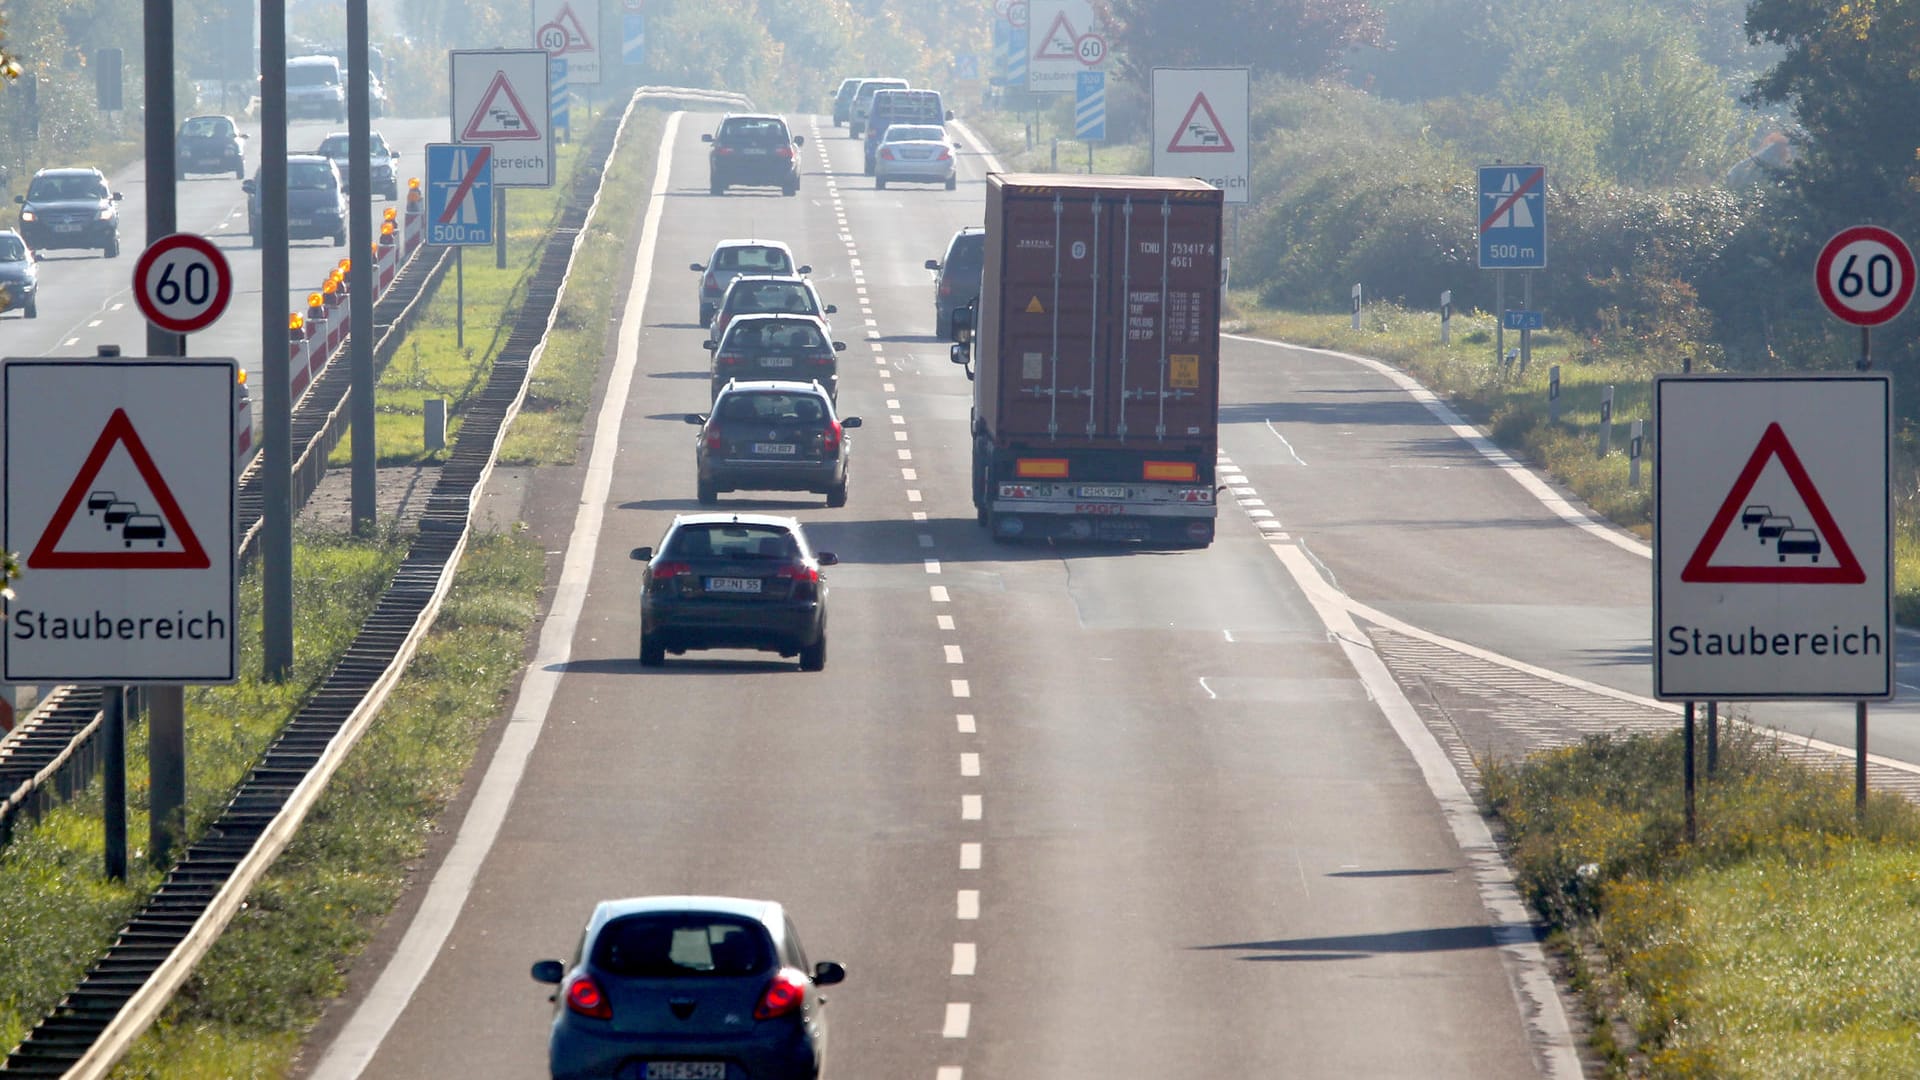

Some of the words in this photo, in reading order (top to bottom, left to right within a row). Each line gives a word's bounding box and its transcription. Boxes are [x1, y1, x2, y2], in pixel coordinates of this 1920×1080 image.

[544, 32, 563, 48] 60
[1081, 42, 1100, 57] 60
[493, 156, 544, 169] bereich
[1202, 175, 1246, 188] reich
[434, 225, 465, 241] 500
[470, 229, 485, 240] m
[1171, 243, 1204, 255] 753417
[1490, 244, 1518, 258] 500
[1520, 247, 1535, 258] m
[156, 262, 210, 305] 60
[1838, 253, 1893, 298] 60
[14, 610, 225, 639] Staubereich
[1668, 625, 1881, 655] Staubereich
